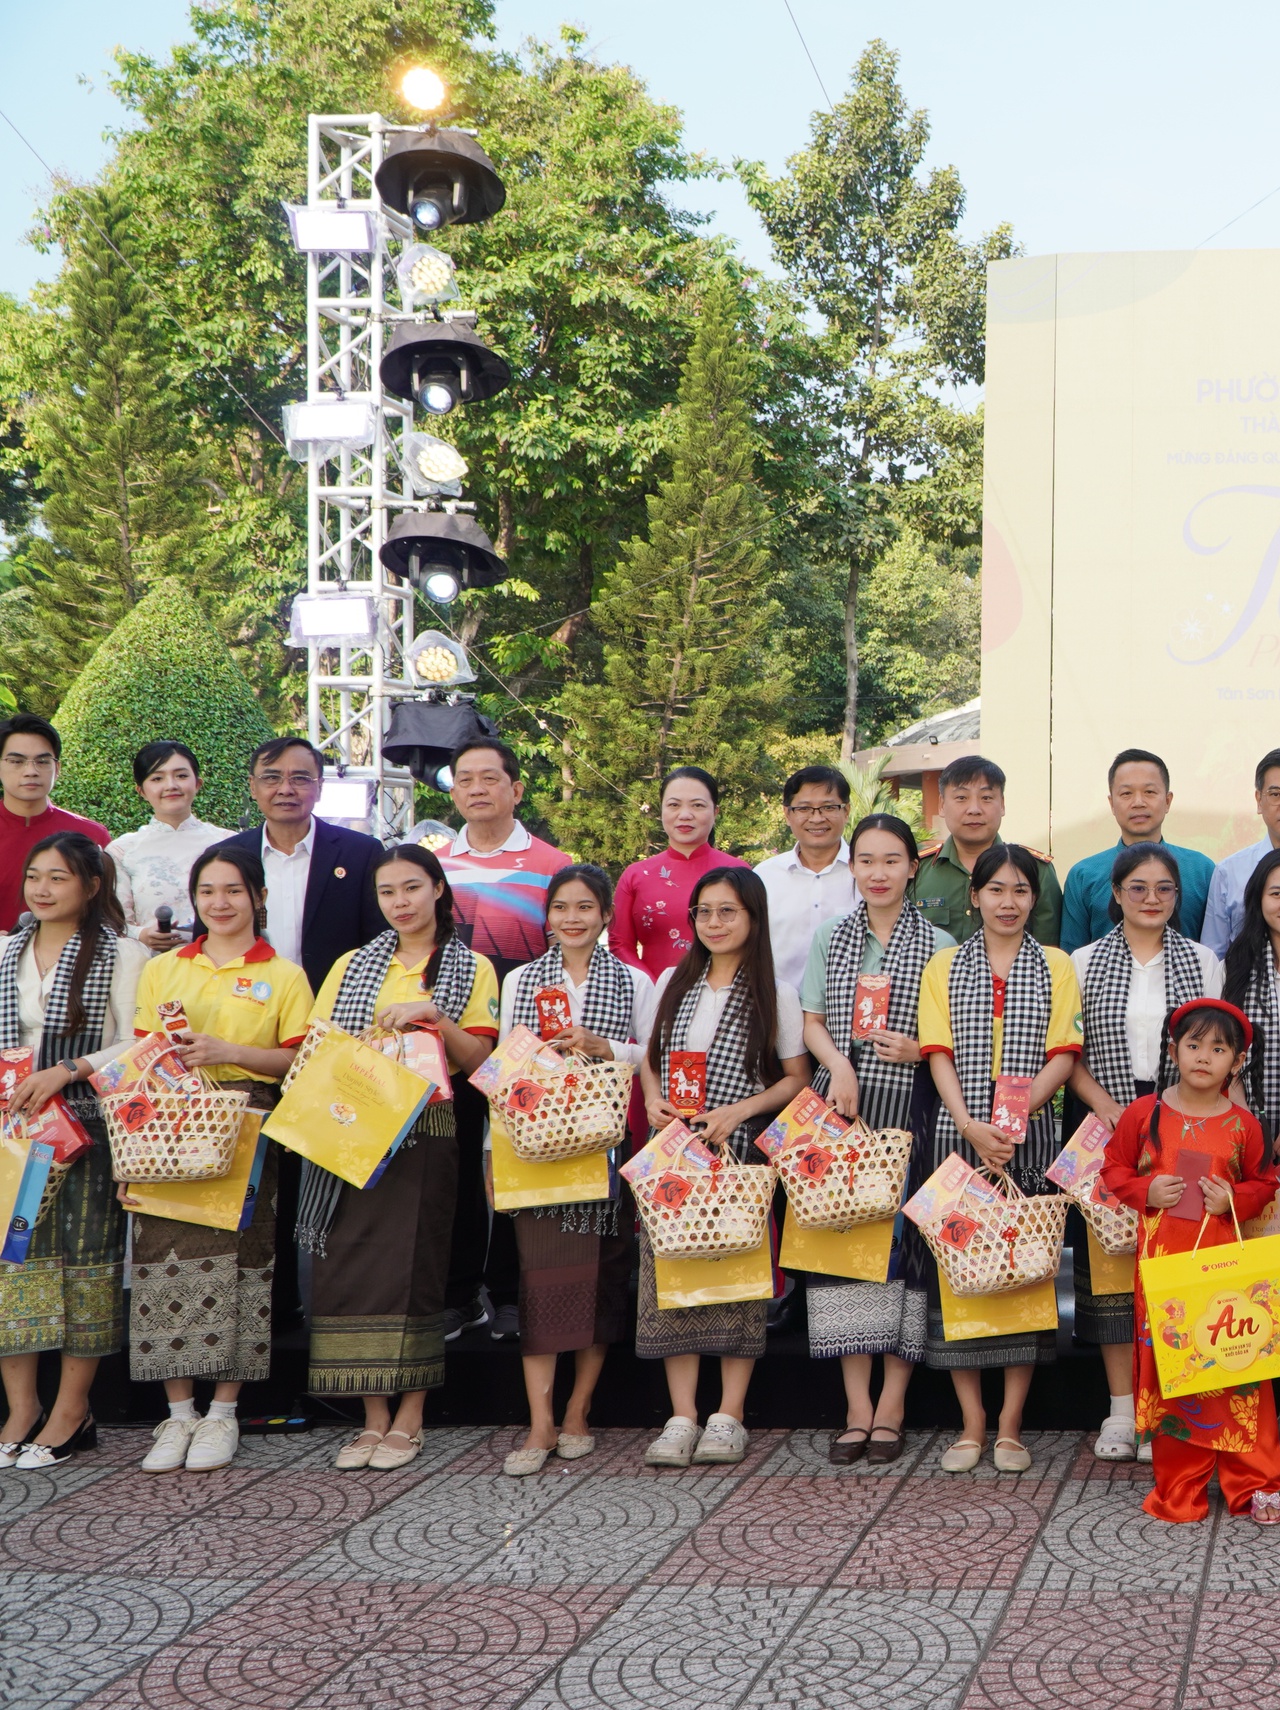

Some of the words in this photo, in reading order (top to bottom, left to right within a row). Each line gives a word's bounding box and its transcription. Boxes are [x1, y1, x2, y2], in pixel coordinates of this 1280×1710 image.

[1166, 449, 1210, 465] MỪNG
[1215, 449, 1258, 464] ĐẢNG
[1216, 687, 1243, 700] Tân
[1246, 687, 1274, 700] Sơn
[350, 1062, 386, 1087] IMPERIAL
[1210, 1259, 1238, 1271] ORION
[1207, 1304, 1260, 1346] An
